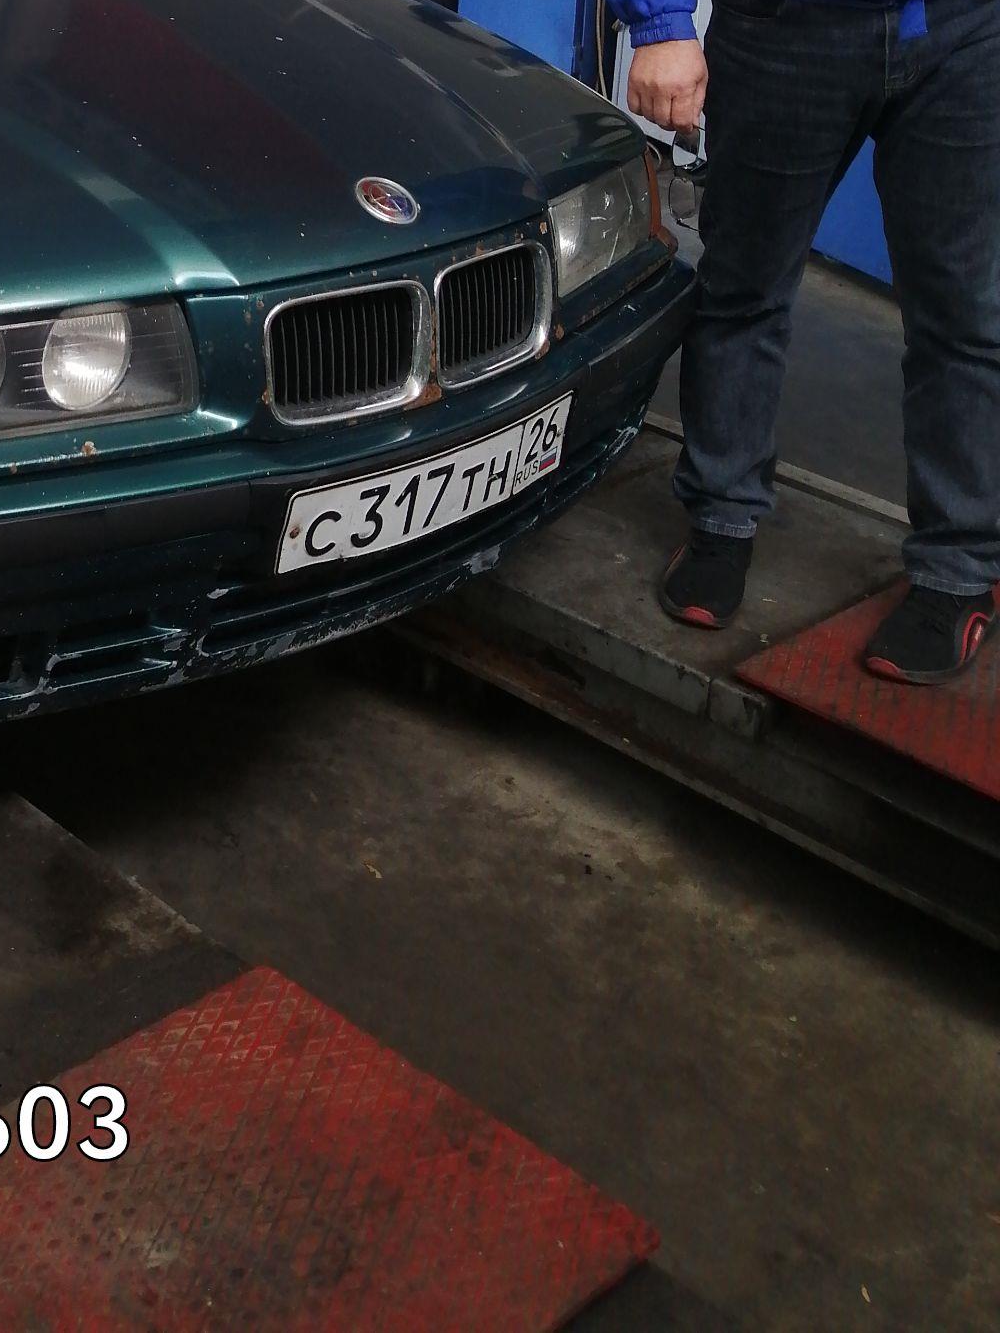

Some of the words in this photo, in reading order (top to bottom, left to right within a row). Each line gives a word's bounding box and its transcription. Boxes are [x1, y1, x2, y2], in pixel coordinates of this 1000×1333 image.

[305, 452, 512, 557] С317ТН
[524, 406, 560, 466] 26
[515, 464, 539, 487] RUS
